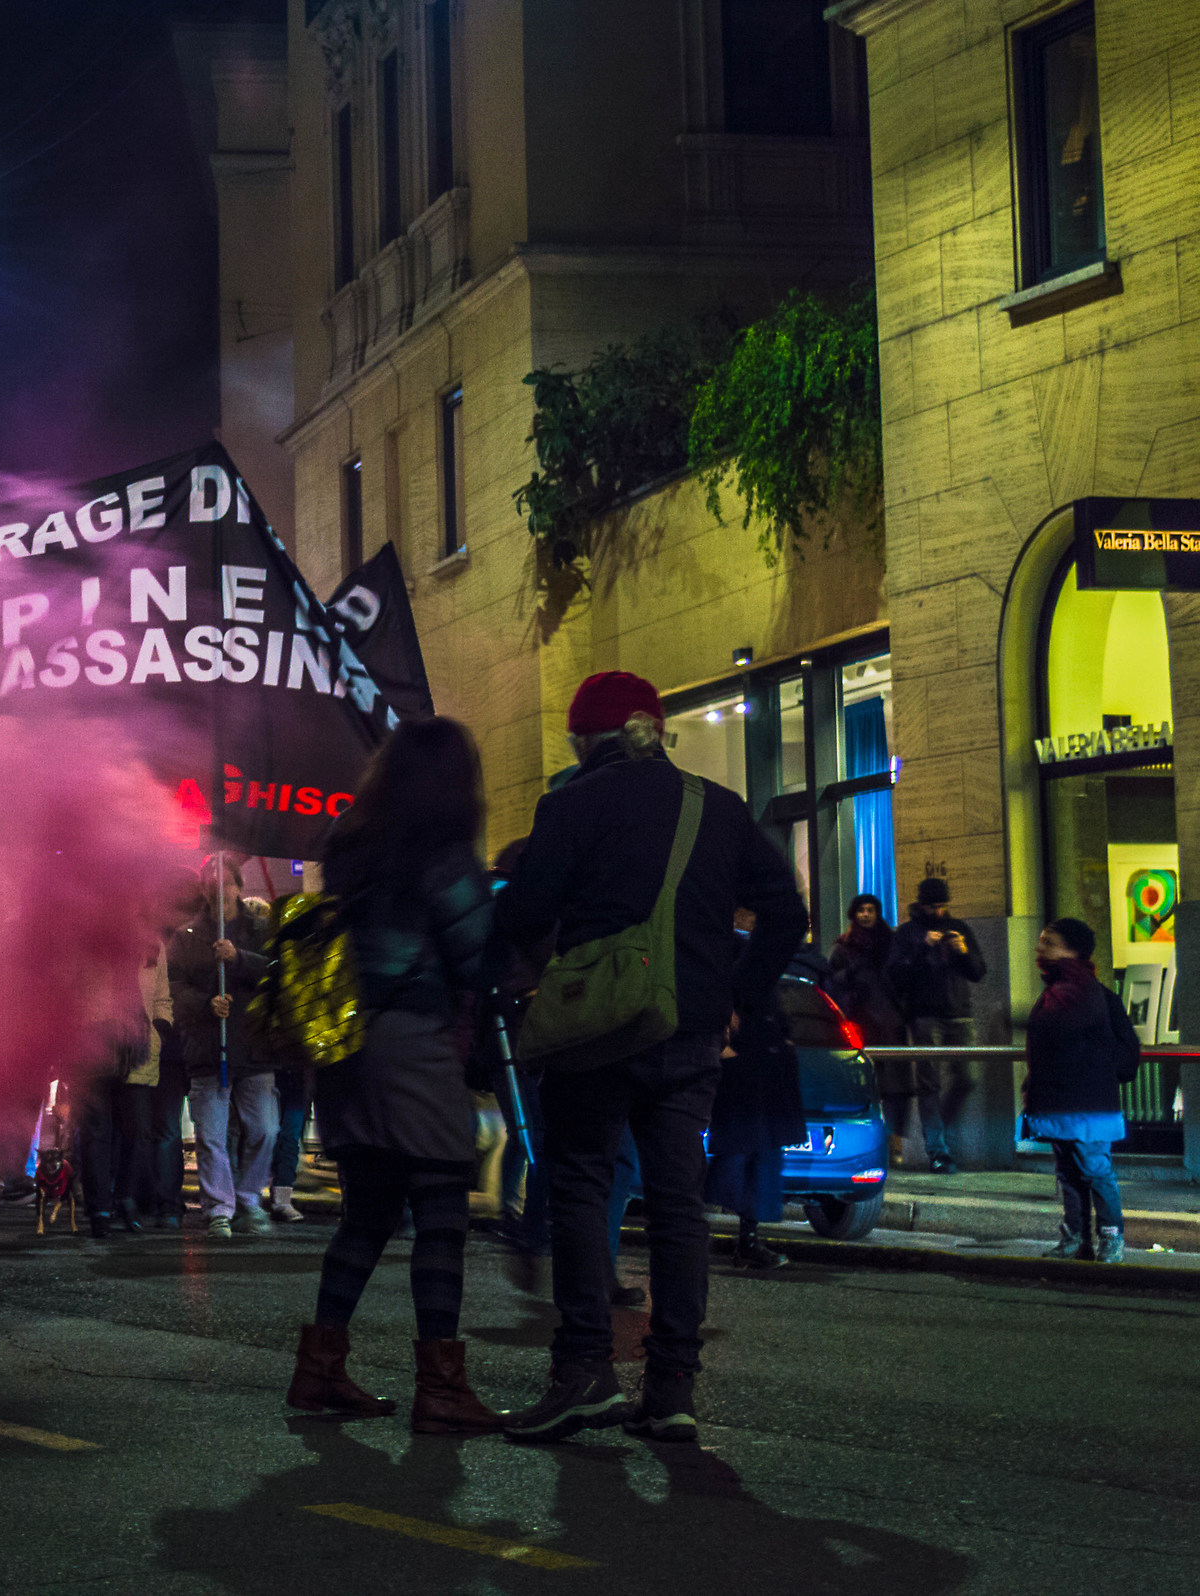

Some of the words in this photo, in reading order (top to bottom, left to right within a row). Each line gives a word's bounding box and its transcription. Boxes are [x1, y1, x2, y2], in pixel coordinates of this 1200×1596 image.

[188, 464, 251, 525] DI
[1094, 532, 1141, 551] Valeria
[1143, 532, 1178, 551] Bella
[1034, 729, 1112, 765] VALERIA
[1112, 720, 1174, 754] BELLA
